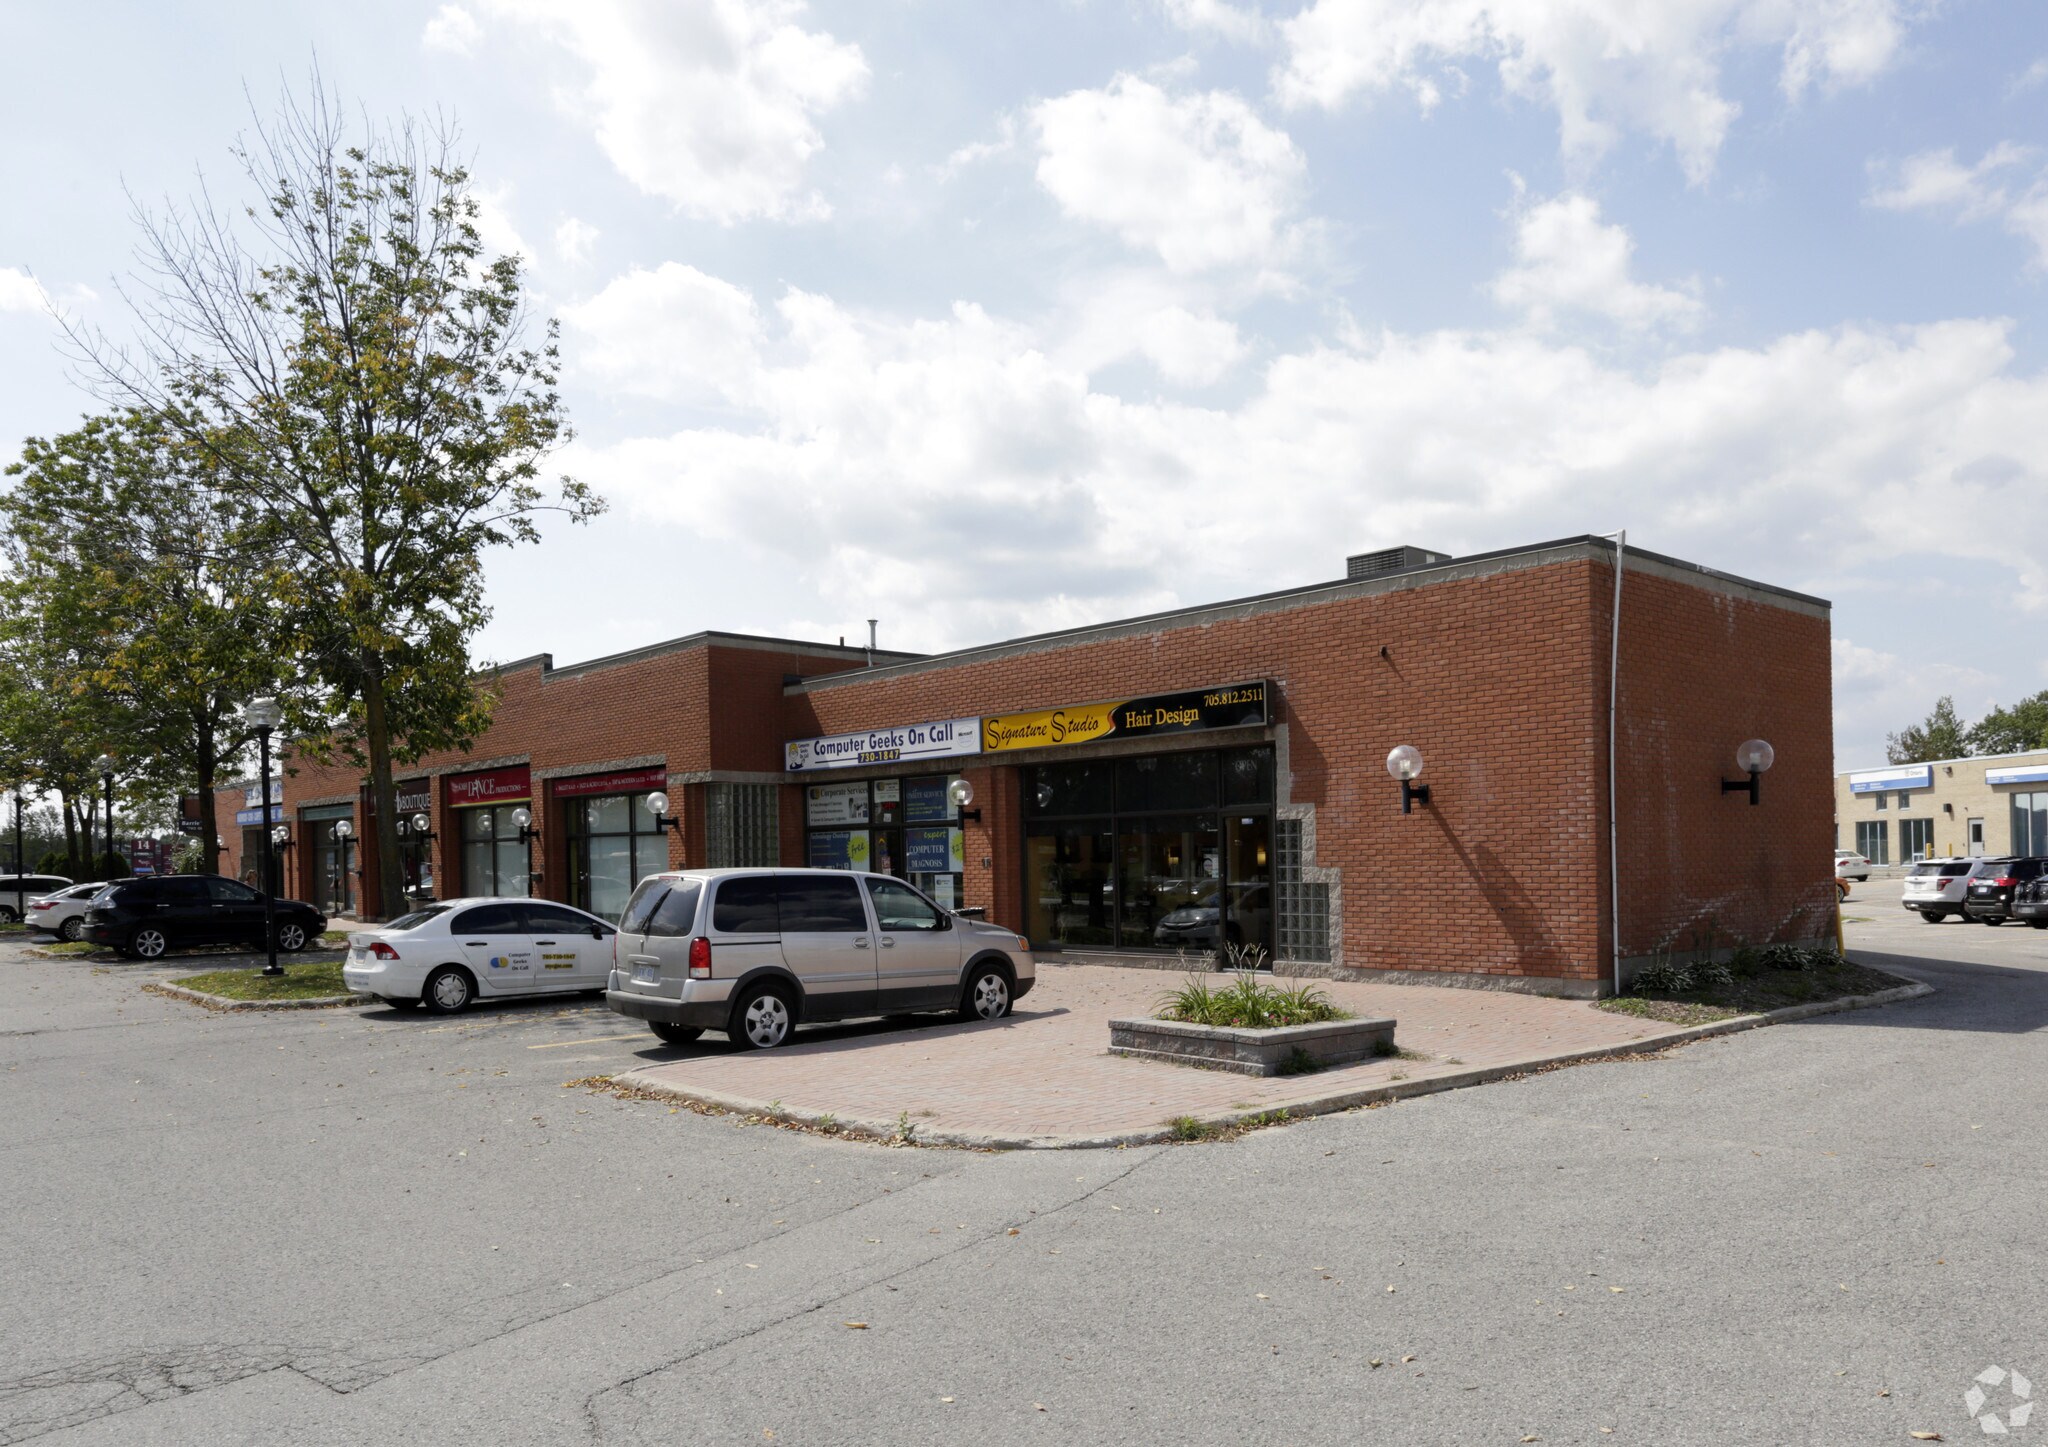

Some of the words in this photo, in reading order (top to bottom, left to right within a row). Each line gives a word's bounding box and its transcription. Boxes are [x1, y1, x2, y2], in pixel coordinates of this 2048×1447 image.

[1204, 689, 1263, 707] 705.812.2511
[1125, 711, 1152, 728] Hair
[1155, 707, 1199, 726] Design
[987, 719, 1047, 749] Signature
[1051, 711, 1099, 743] Studio
[814, 739, 865, 758] Computer
[869, 731, 904, 749] Geeks
[909, 729, 925, 744] On
[929, 723, 953, 742] Call
[860, 750, 899, 763] 730-1847
[821, 787, 847, 798] Corporate
[401, 793, 431, 810] BOUTIQUE
[924, 831, 947, 840] expert
[138, 840, 150, 850] 14
[852, 842, 866, 859] free
[909, 845, 944, 854] COMPUTER
[911, 859, 943, 868] DIAGNOSIS
